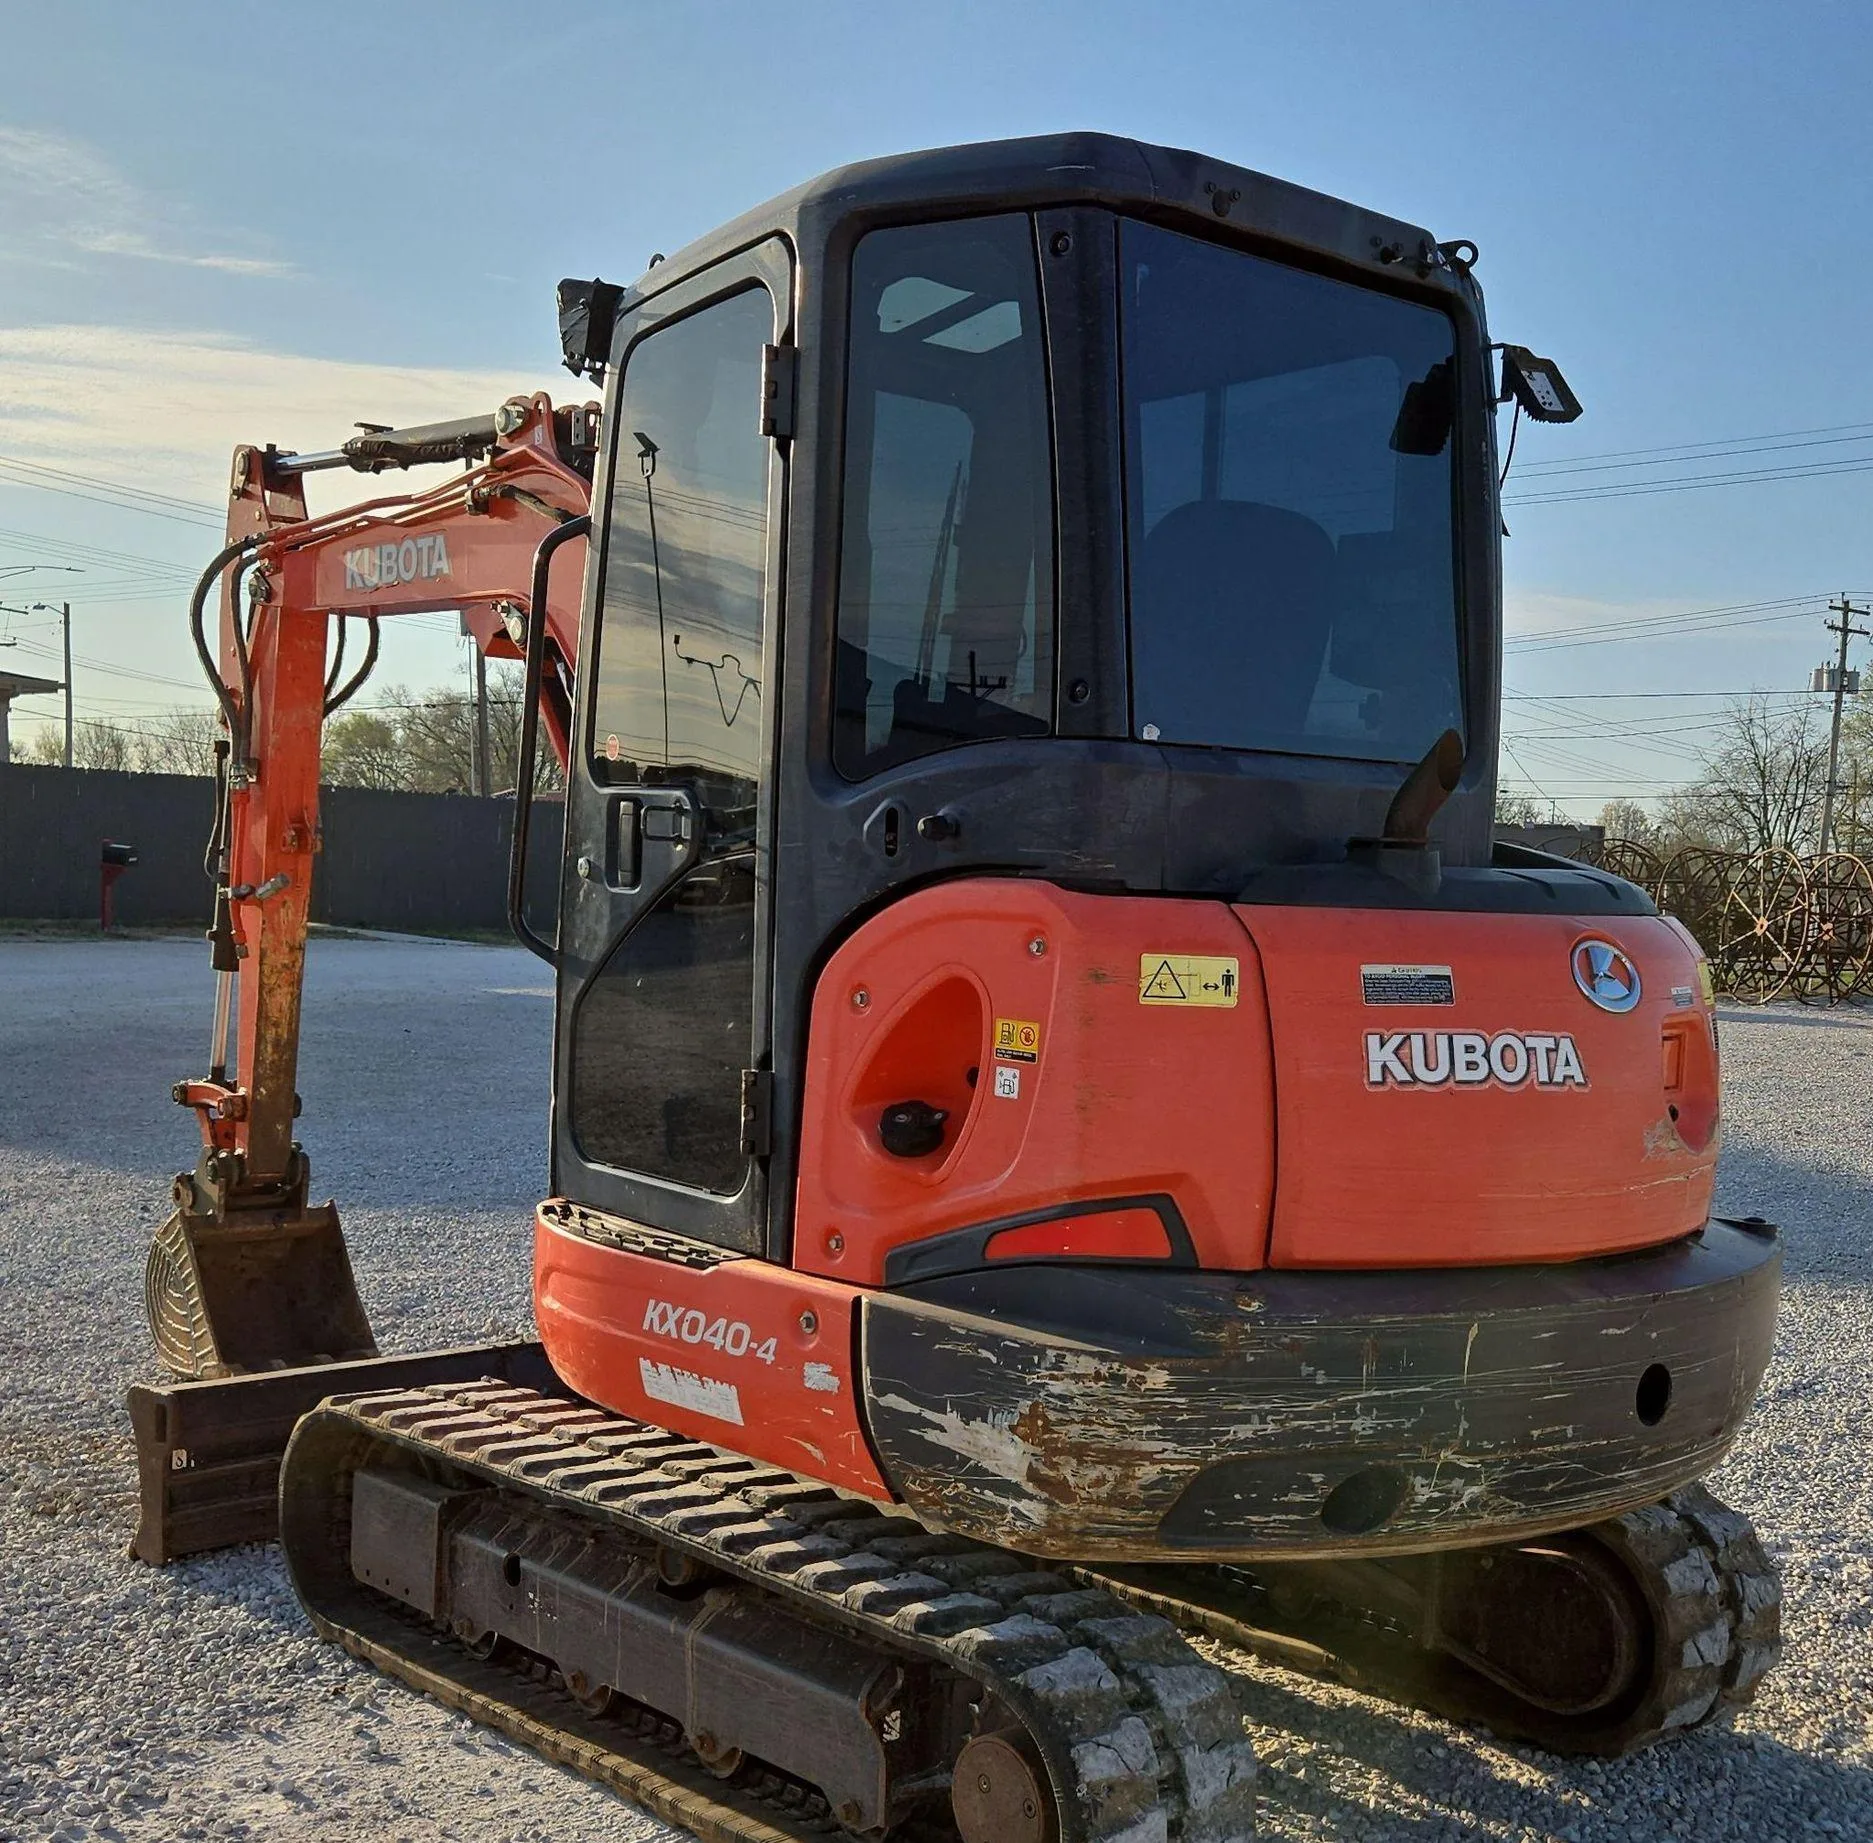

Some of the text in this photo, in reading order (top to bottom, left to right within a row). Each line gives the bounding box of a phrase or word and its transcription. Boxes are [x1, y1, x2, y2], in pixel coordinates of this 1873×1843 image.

[344, 534, 450, 590] KUBOTA
[1365, 1032, 1587, 1086] KUBOTA
[642, 1298, 777, 1365] KX040-4
